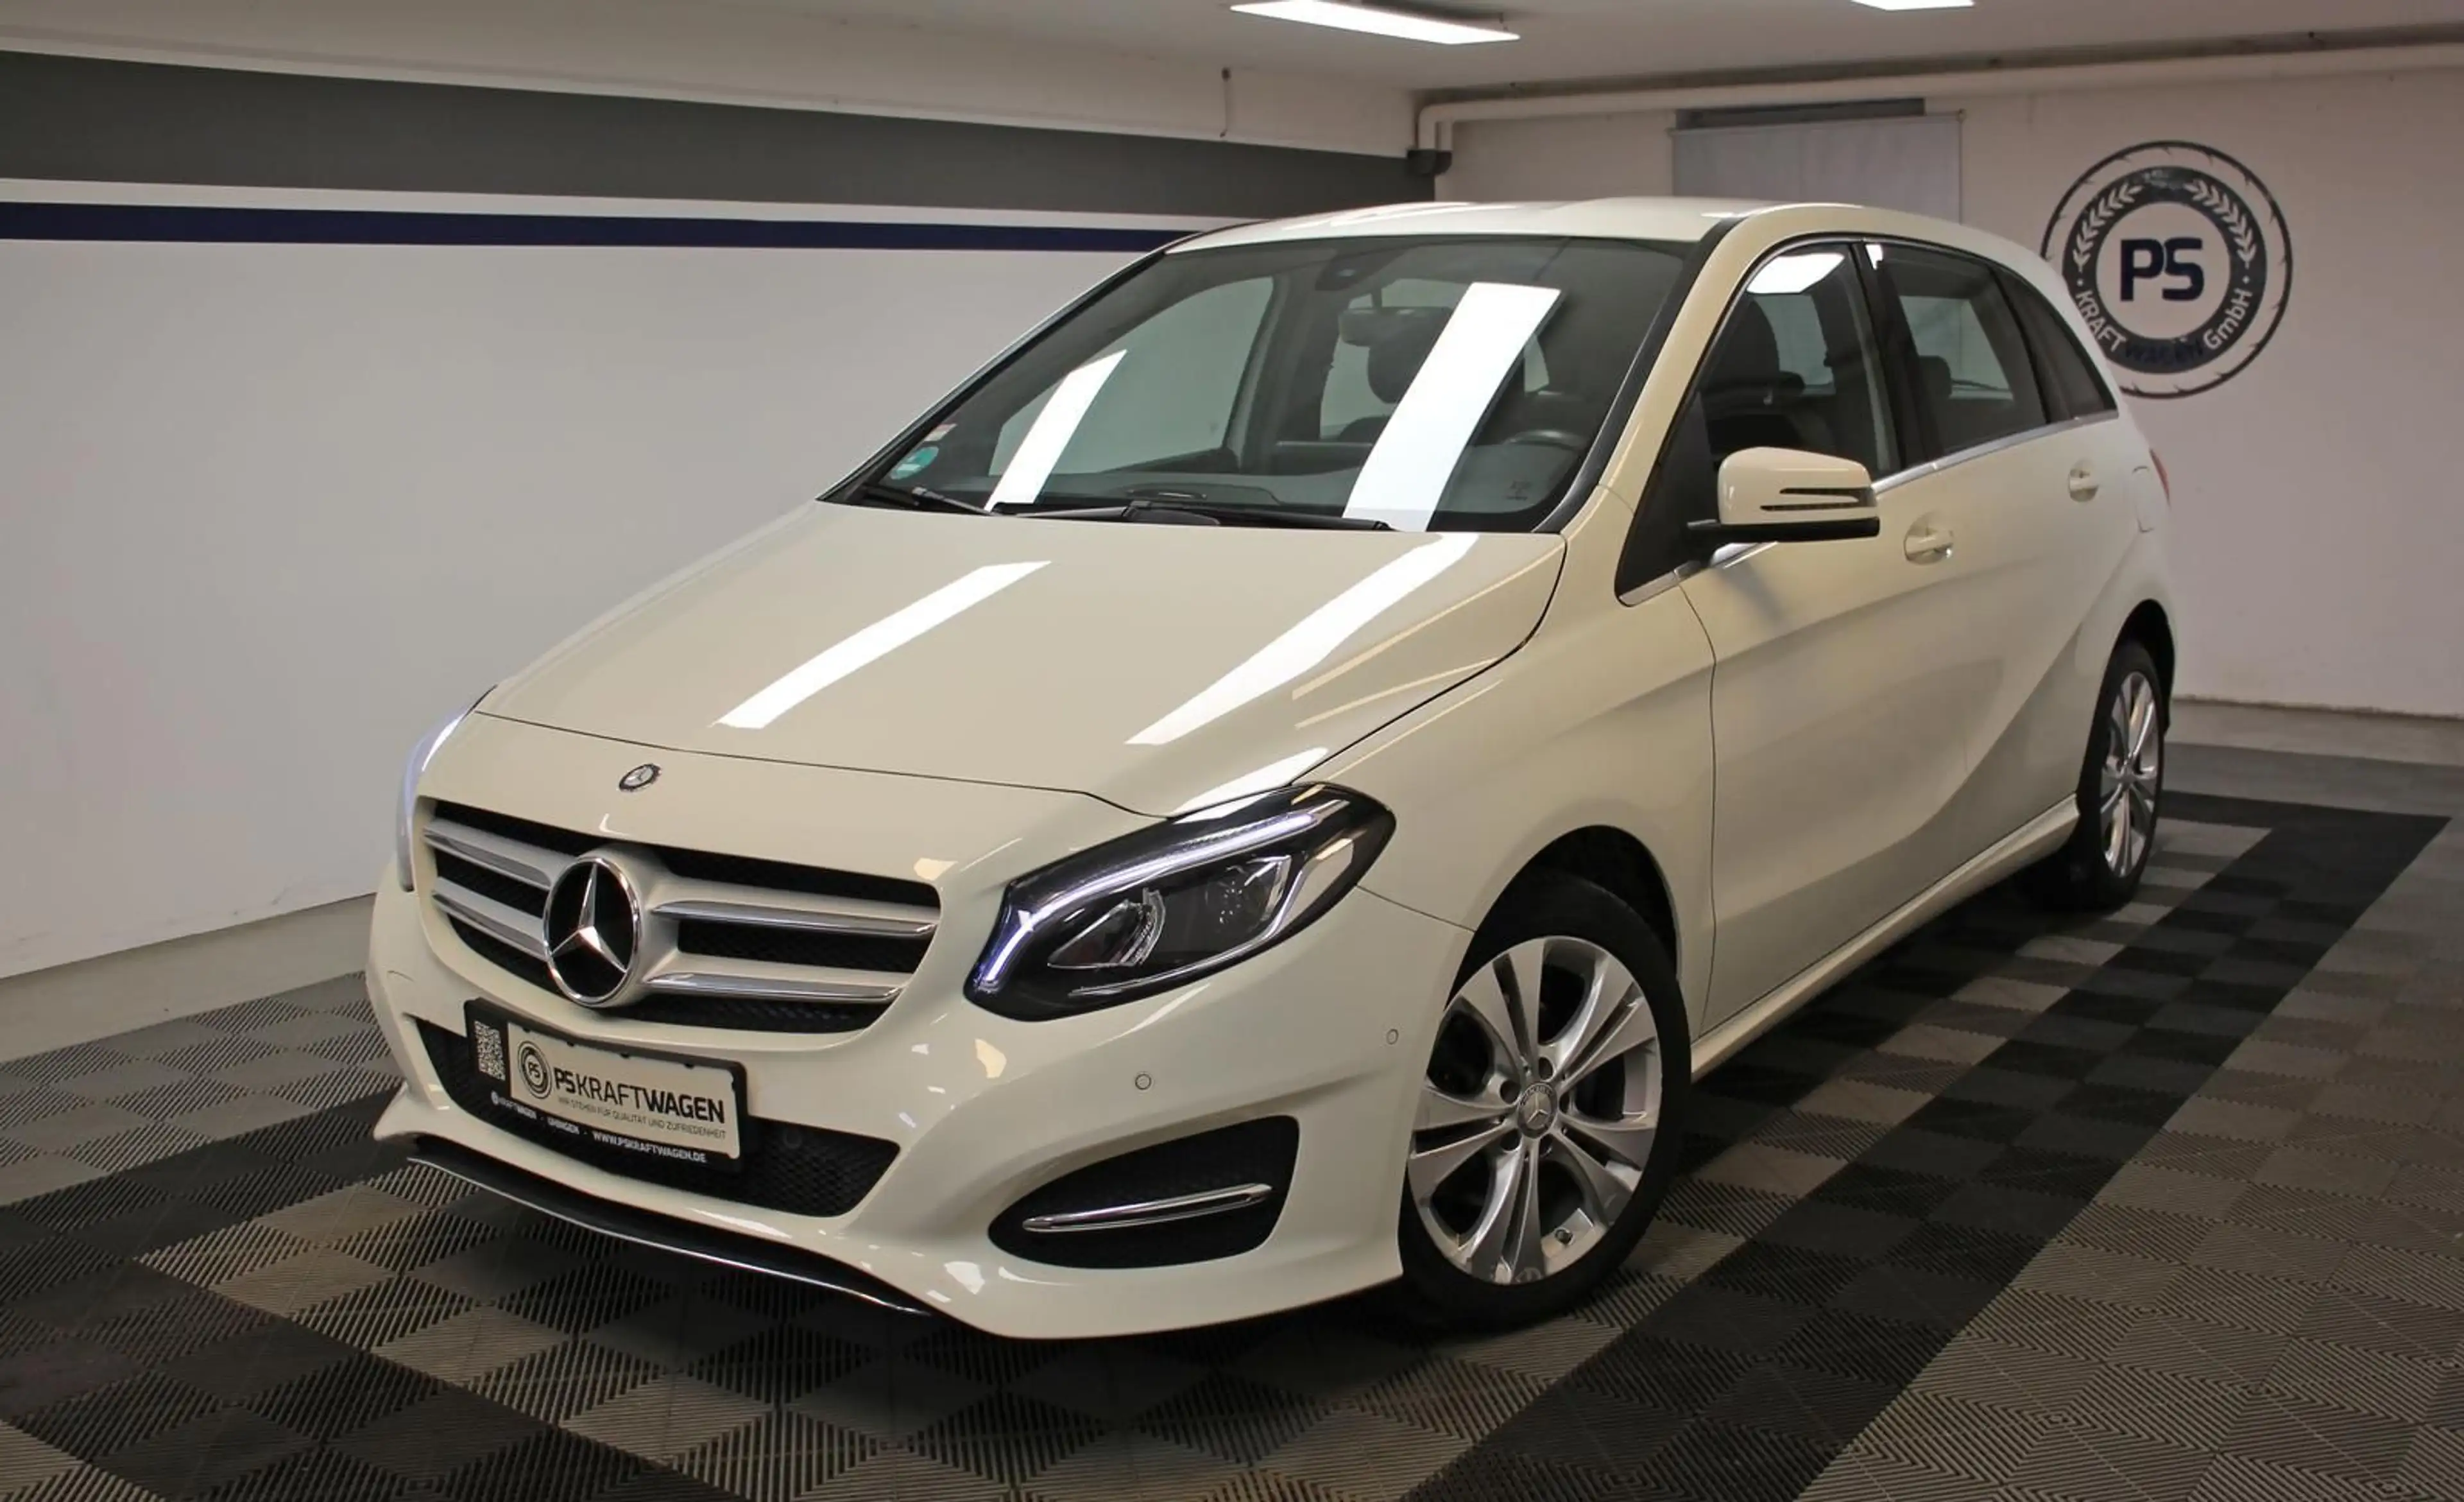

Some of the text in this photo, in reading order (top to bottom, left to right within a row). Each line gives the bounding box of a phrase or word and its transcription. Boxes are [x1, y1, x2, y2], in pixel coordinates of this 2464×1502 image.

[2120, 237, 2205, 302] PS
[2076, 289, 2127, 352] KRAFT
[2202, 287, 2253, 350] GmbH
